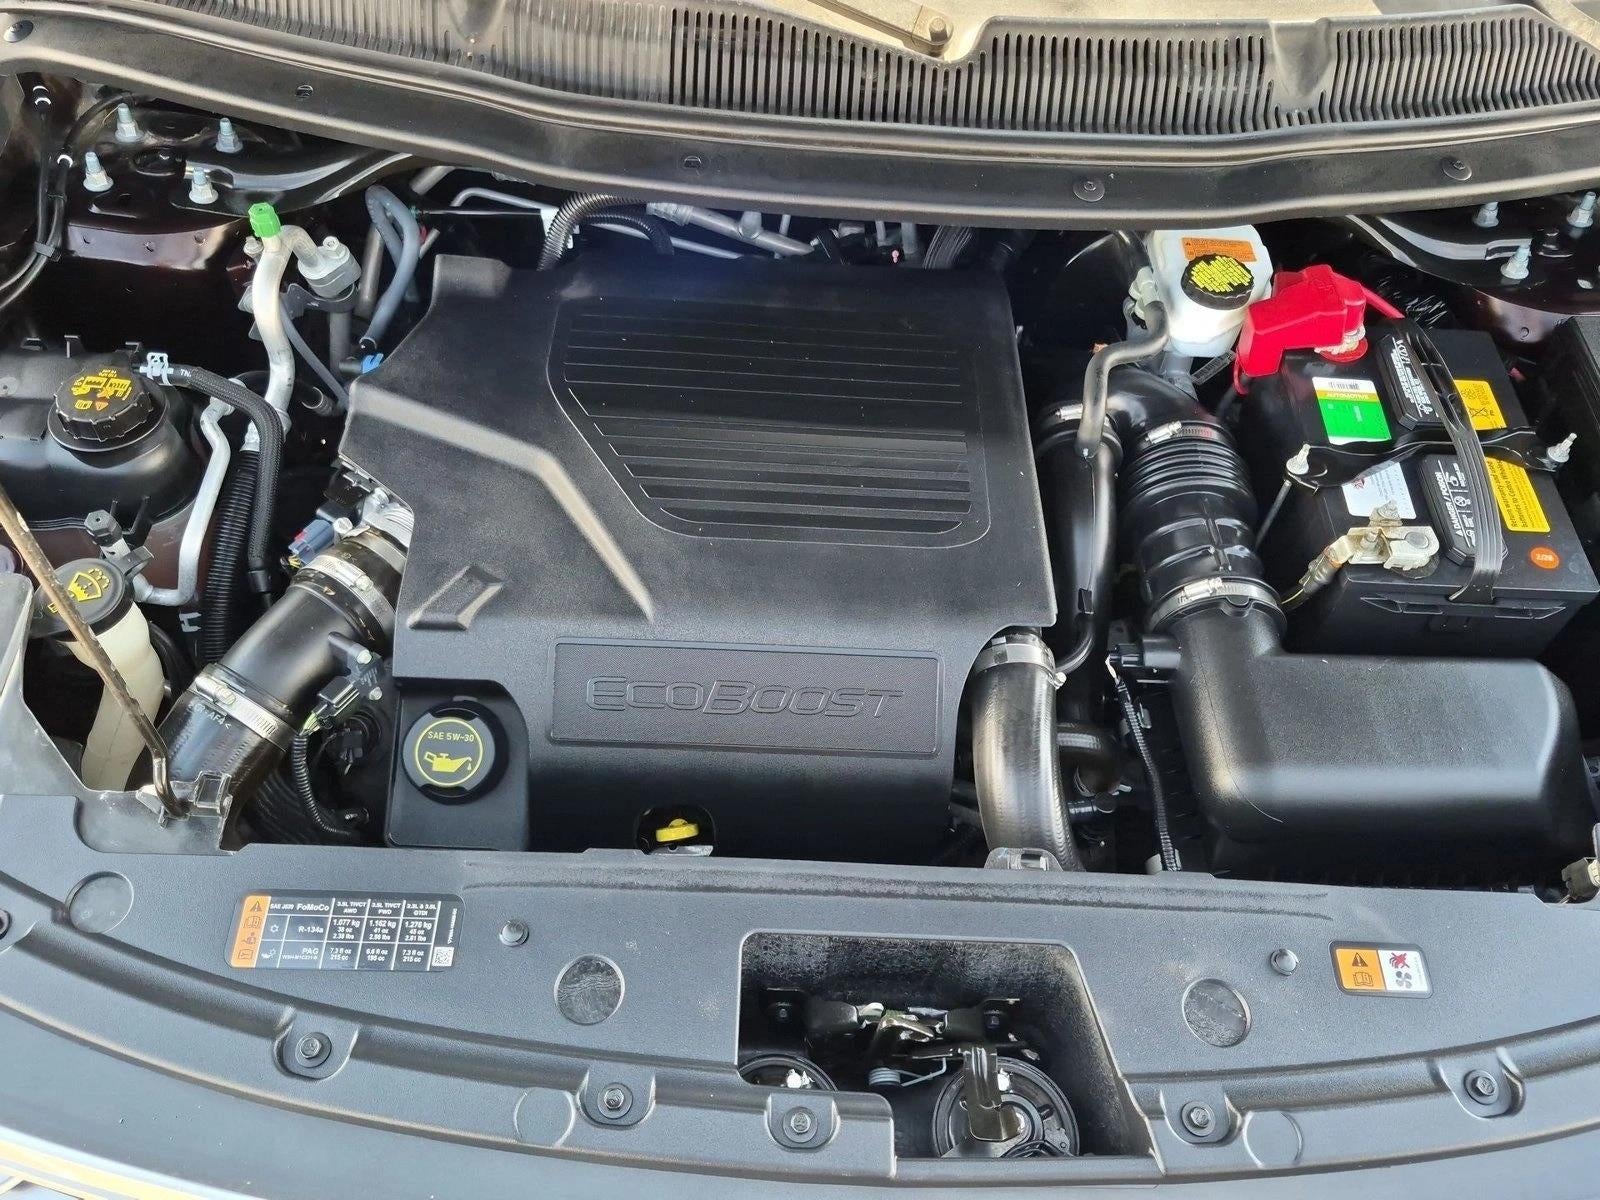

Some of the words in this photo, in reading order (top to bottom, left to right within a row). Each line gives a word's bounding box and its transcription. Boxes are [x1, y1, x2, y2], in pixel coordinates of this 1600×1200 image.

[427, 731, 444, 740] SAE
[446, 732, 474, 742] 5W-30
[297, 903, 329, 912] FoMoCo
[298, 925, 323, 933] R-134a
[388, 921, 396, 929] kg
[423, 922, 432, 930] kg
